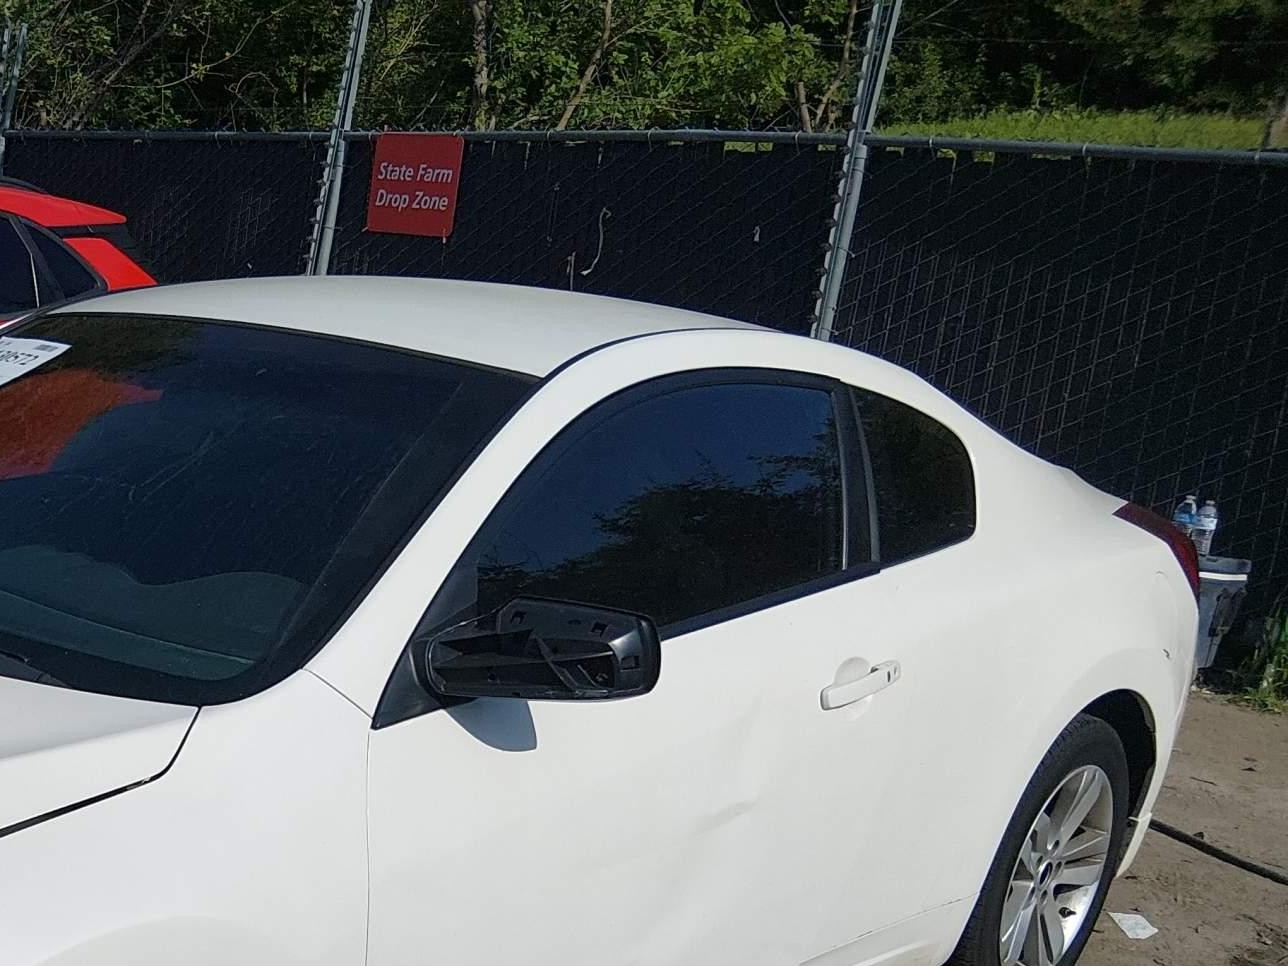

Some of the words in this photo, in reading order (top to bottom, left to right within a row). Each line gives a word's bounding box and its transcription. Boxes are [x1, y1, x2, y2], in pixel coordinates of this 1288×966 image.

[377, 161, 414, 181] State
[416, 164, 453, 183] Farm
[375, 189, 409, 213] Drop
[411, 191, 449, 211] Zone
